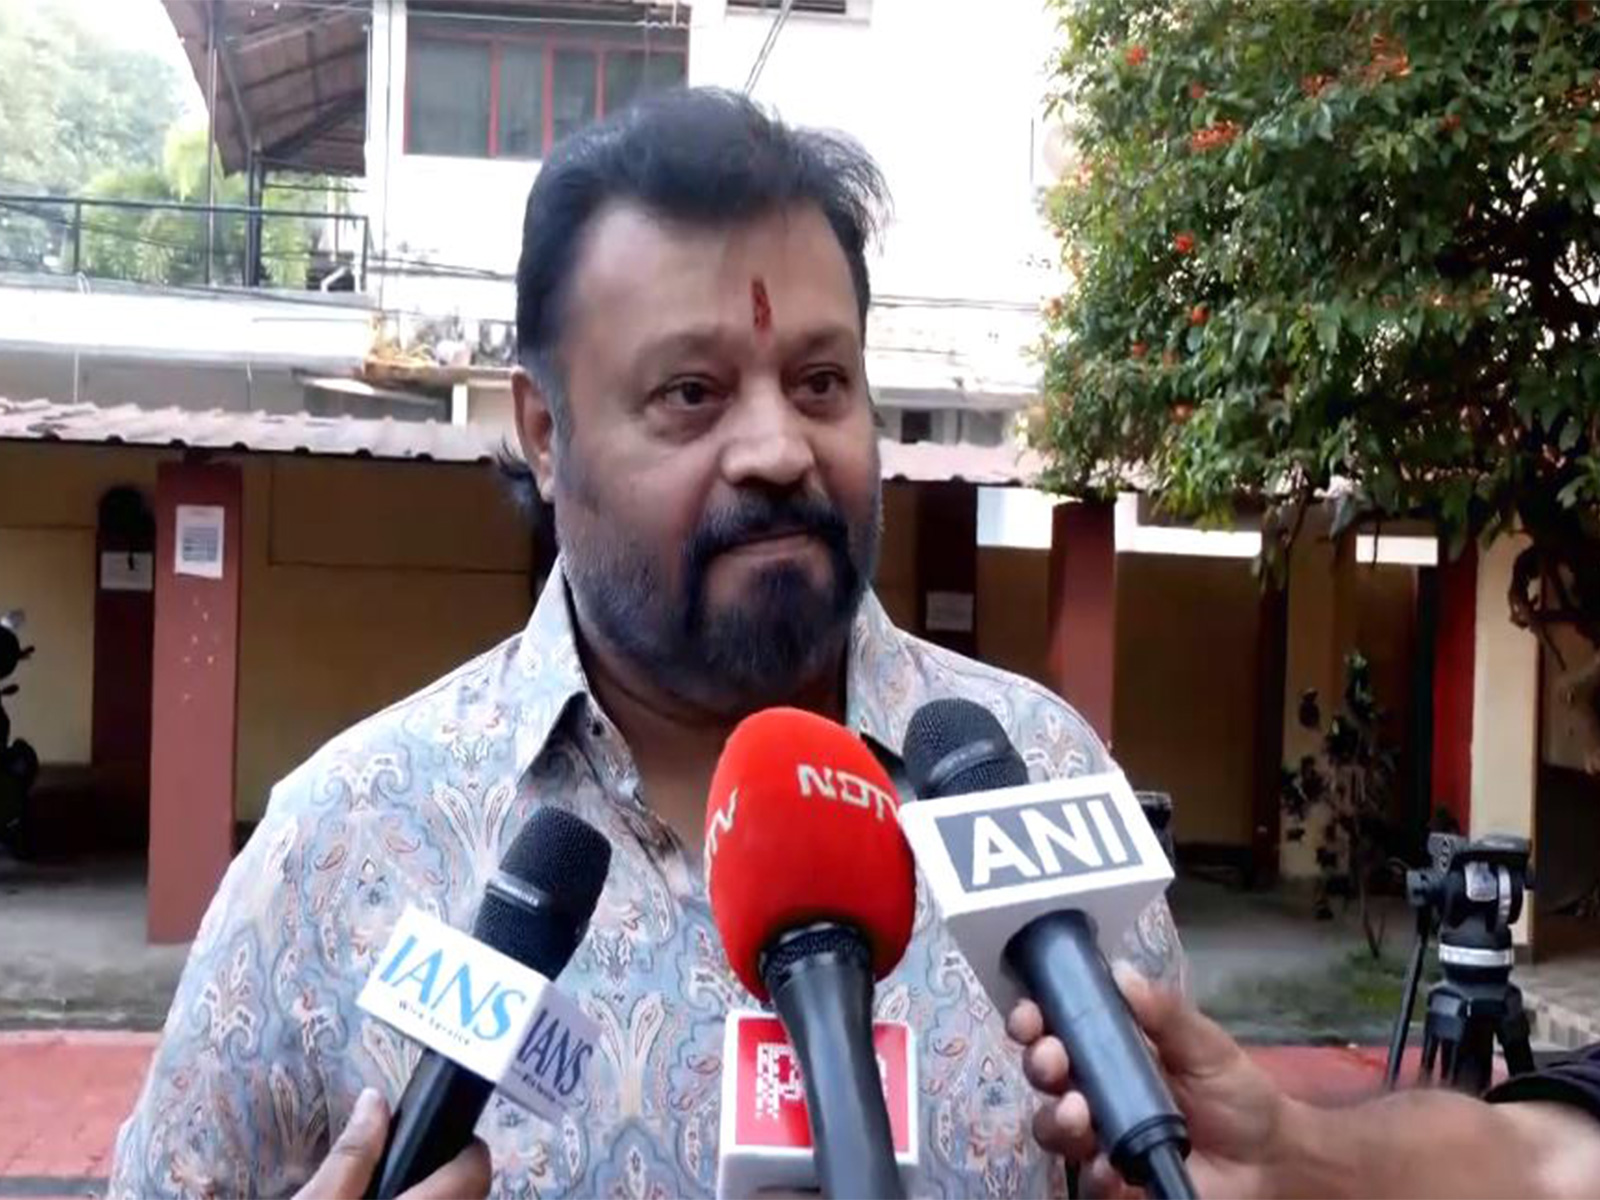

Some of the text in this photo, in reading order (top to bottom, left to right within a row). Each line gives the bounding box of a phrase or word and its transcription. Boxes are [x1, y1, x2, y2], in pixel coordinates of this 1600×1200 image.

[971, 799, 1129, 887] ANI
[378, 934, 527, 1041] IANS
[517, 1007, 594, 1096] IANS
